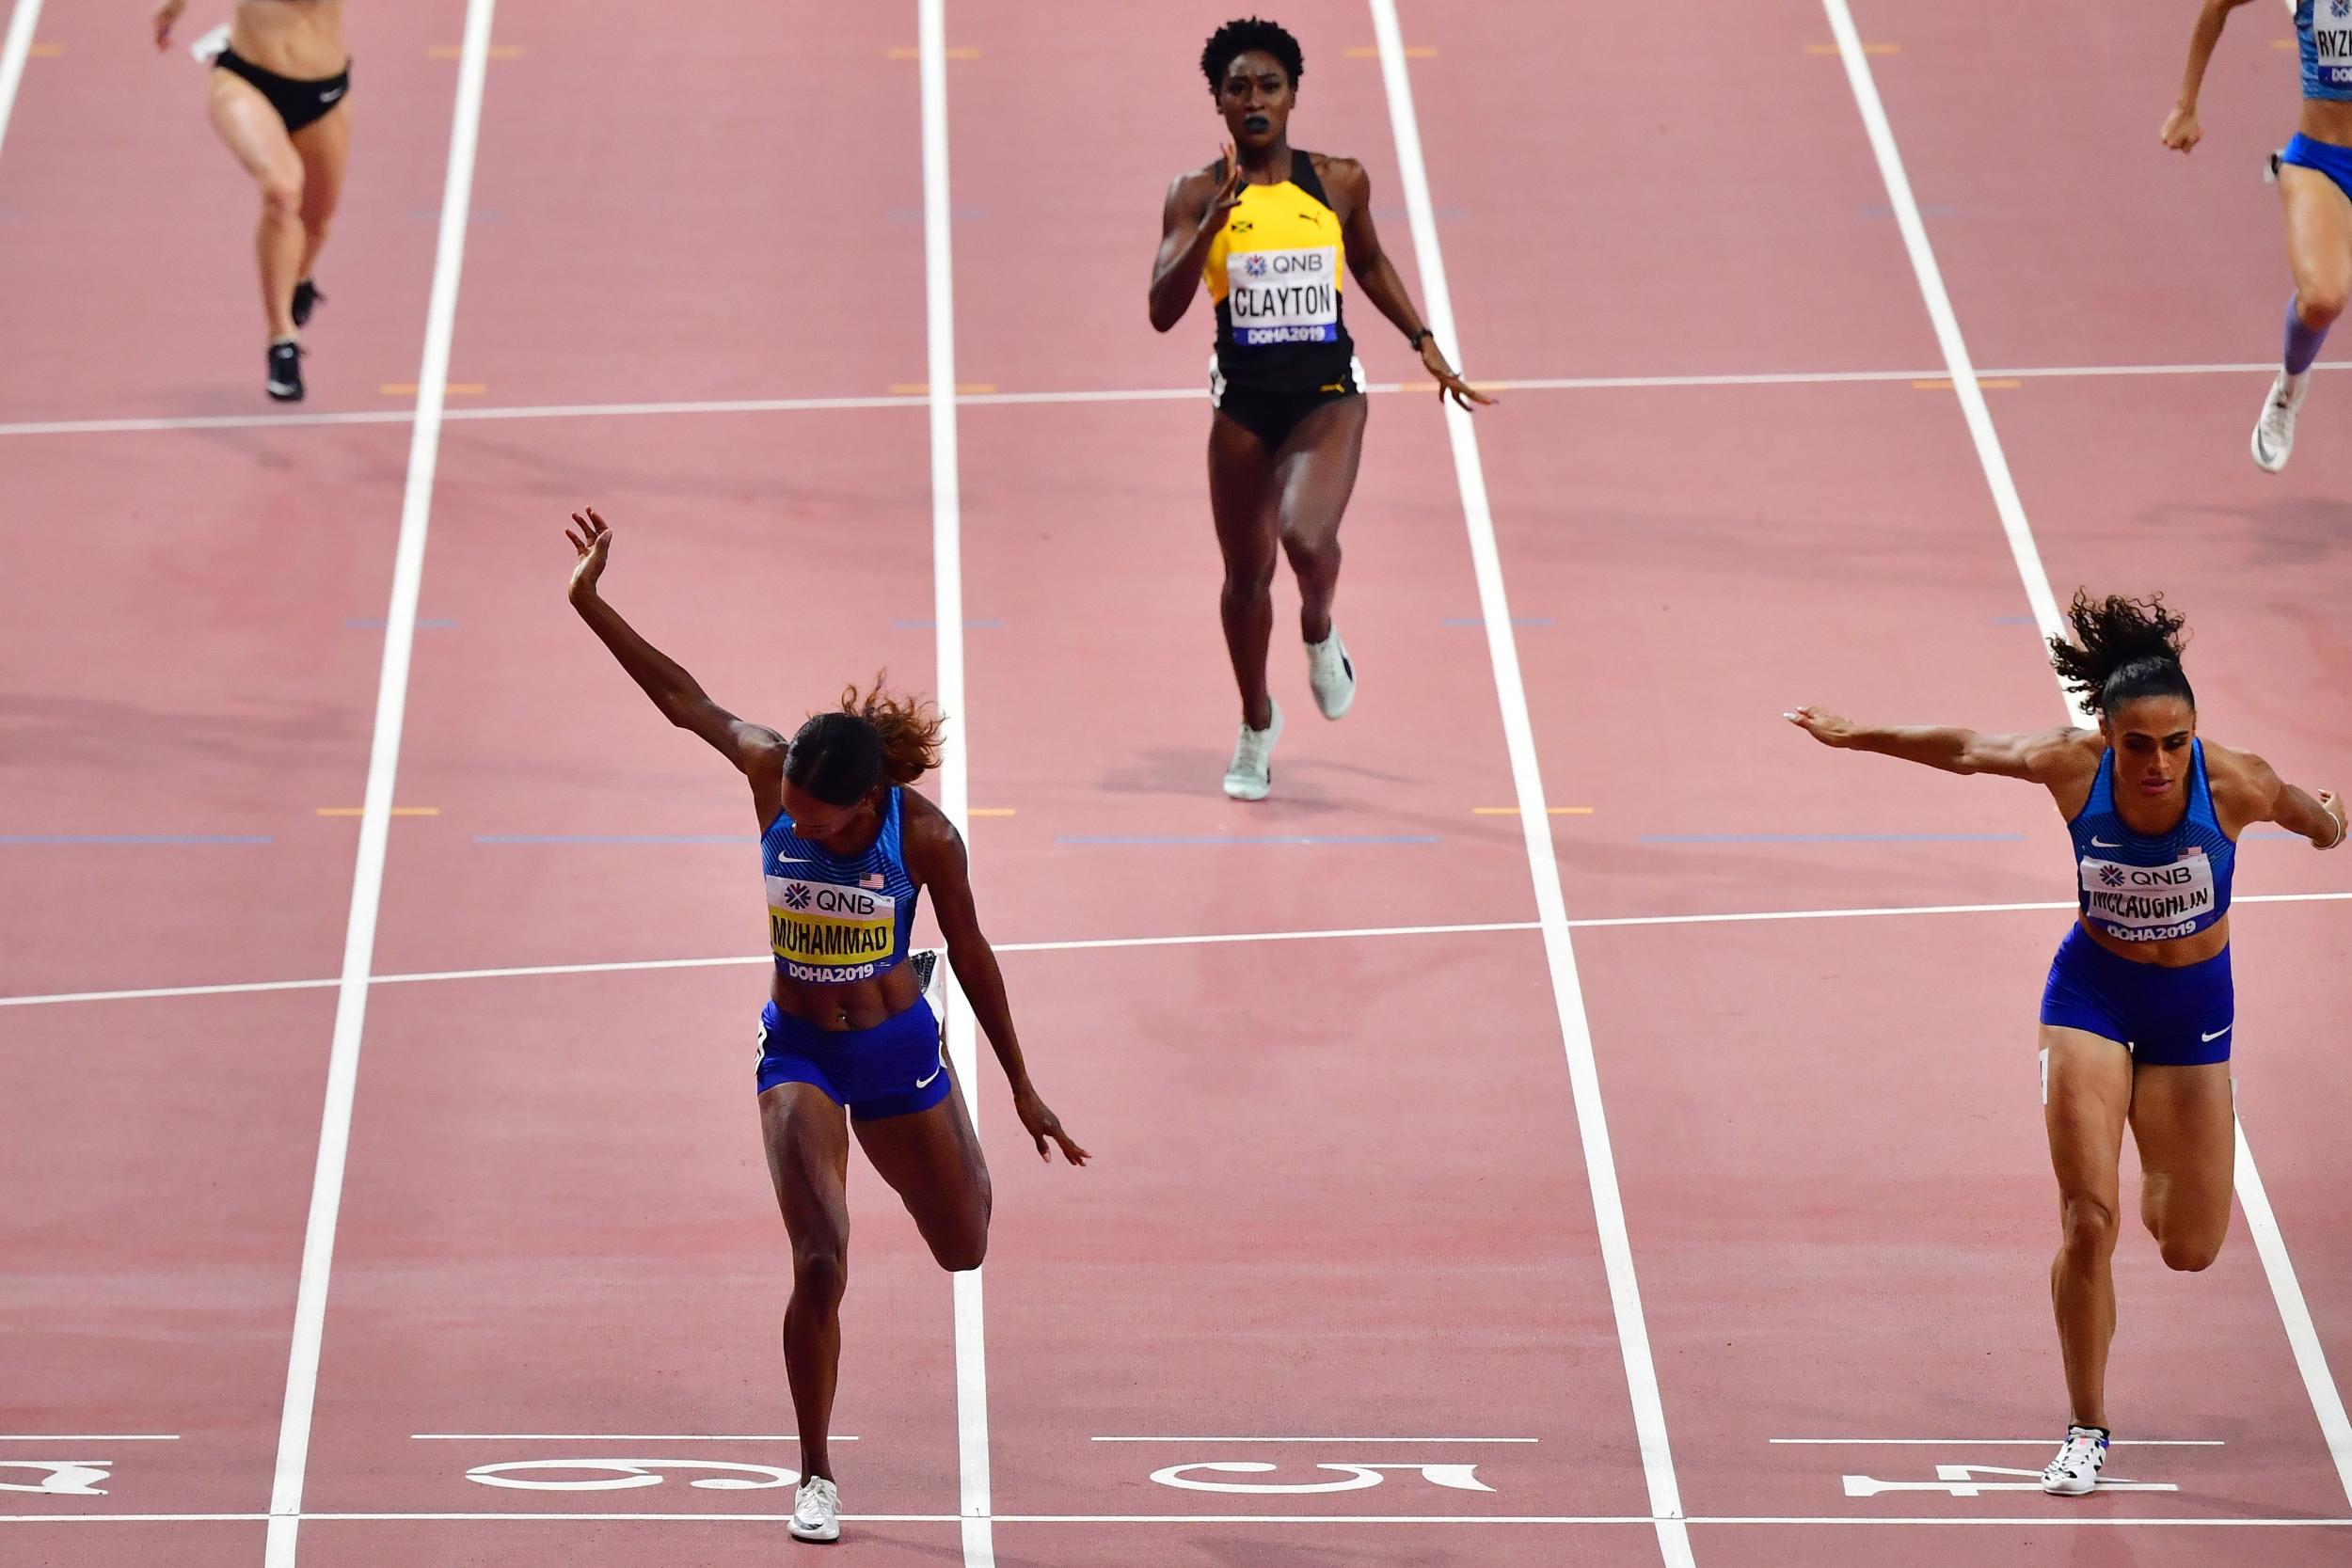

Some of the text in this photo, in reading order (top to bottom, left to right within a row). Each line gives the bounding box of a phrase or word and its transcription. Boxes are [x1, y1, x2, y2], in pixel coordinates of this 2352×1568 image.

[2317, 29, 2352, 57] RYZ
[1273, 254, 1323, 274] QNB
[1234, 283, 1330, 317] CLAYTON
[1248, 326, 1326, 344] DOHA2019
[2131, 866, 2192, 885] QNB
[817, 889, 875, 914] QNB
[2092, 887, 2208, 919] MCLAUGHLIN
[771, 914, 887, 955] MUHAMMAD
[2106, 920, 2197, 942] DOHA2019
[788, 962, 874, 982] DOHA2019
[465, 1458, 802, 1491] 6
[1150, 1461, 1498, 1494] 5
[1841, 1465, 2179, 1497] 4
